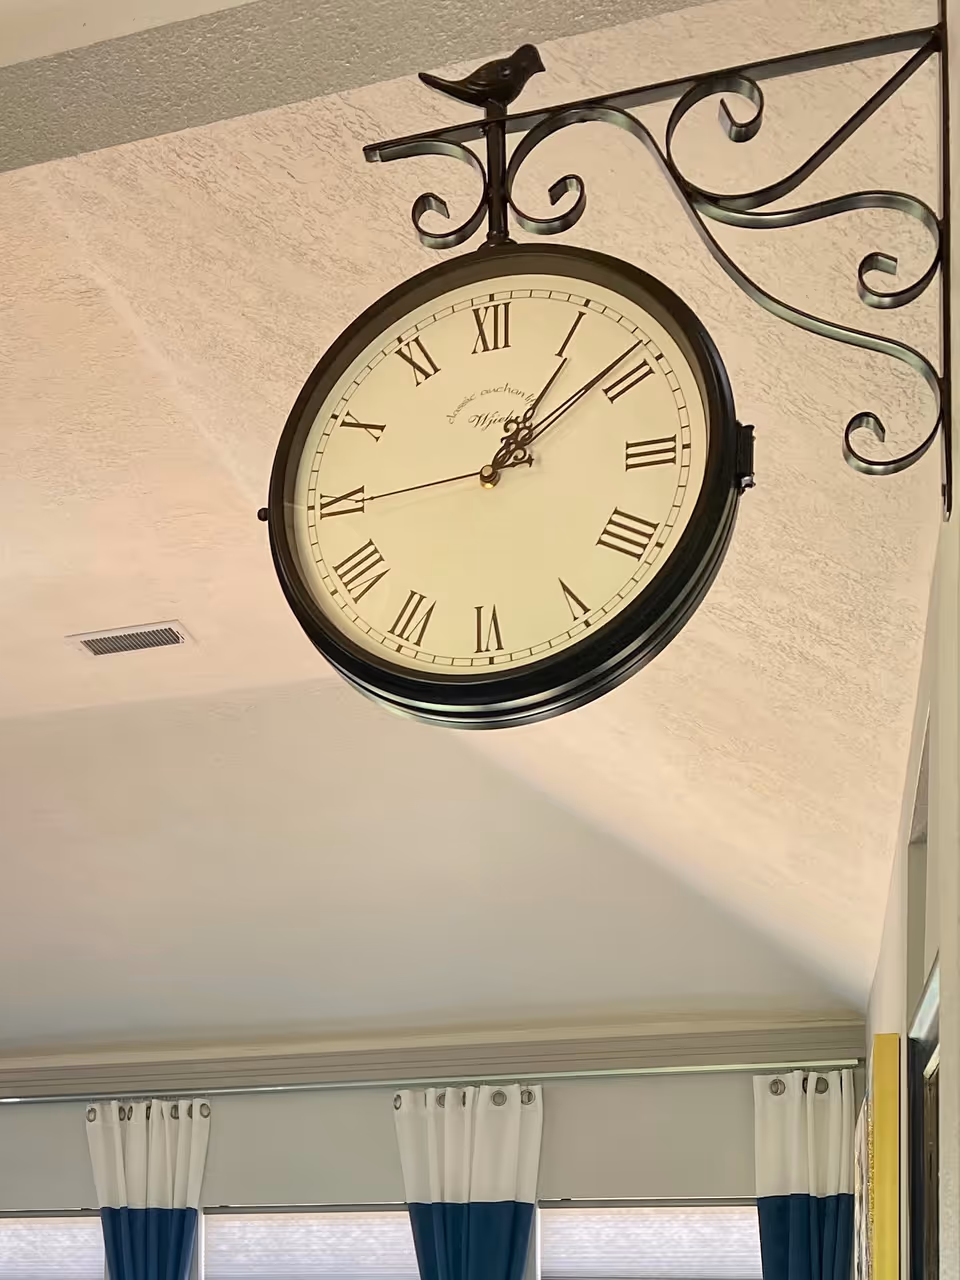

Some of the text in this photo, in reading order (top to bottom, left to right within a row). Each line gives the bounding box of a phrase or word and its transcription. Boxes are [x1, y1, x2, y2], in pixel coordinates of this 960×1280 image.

[471, 301, 512, 354] XII
[395, 335, 441, 386] XI
[602, 358, 656, 403] II
[339, 410, 386, 442] X
[625, 433, 677, 472] III
[319, 485, 365, 520] IX
[595, 507, 660, 562] IIII
[332, 538, 391, 604] VIII
[388, 589, 437, 647] VII
[558, 577, 591, 621] V
[474, 603, 504, 654] VI
